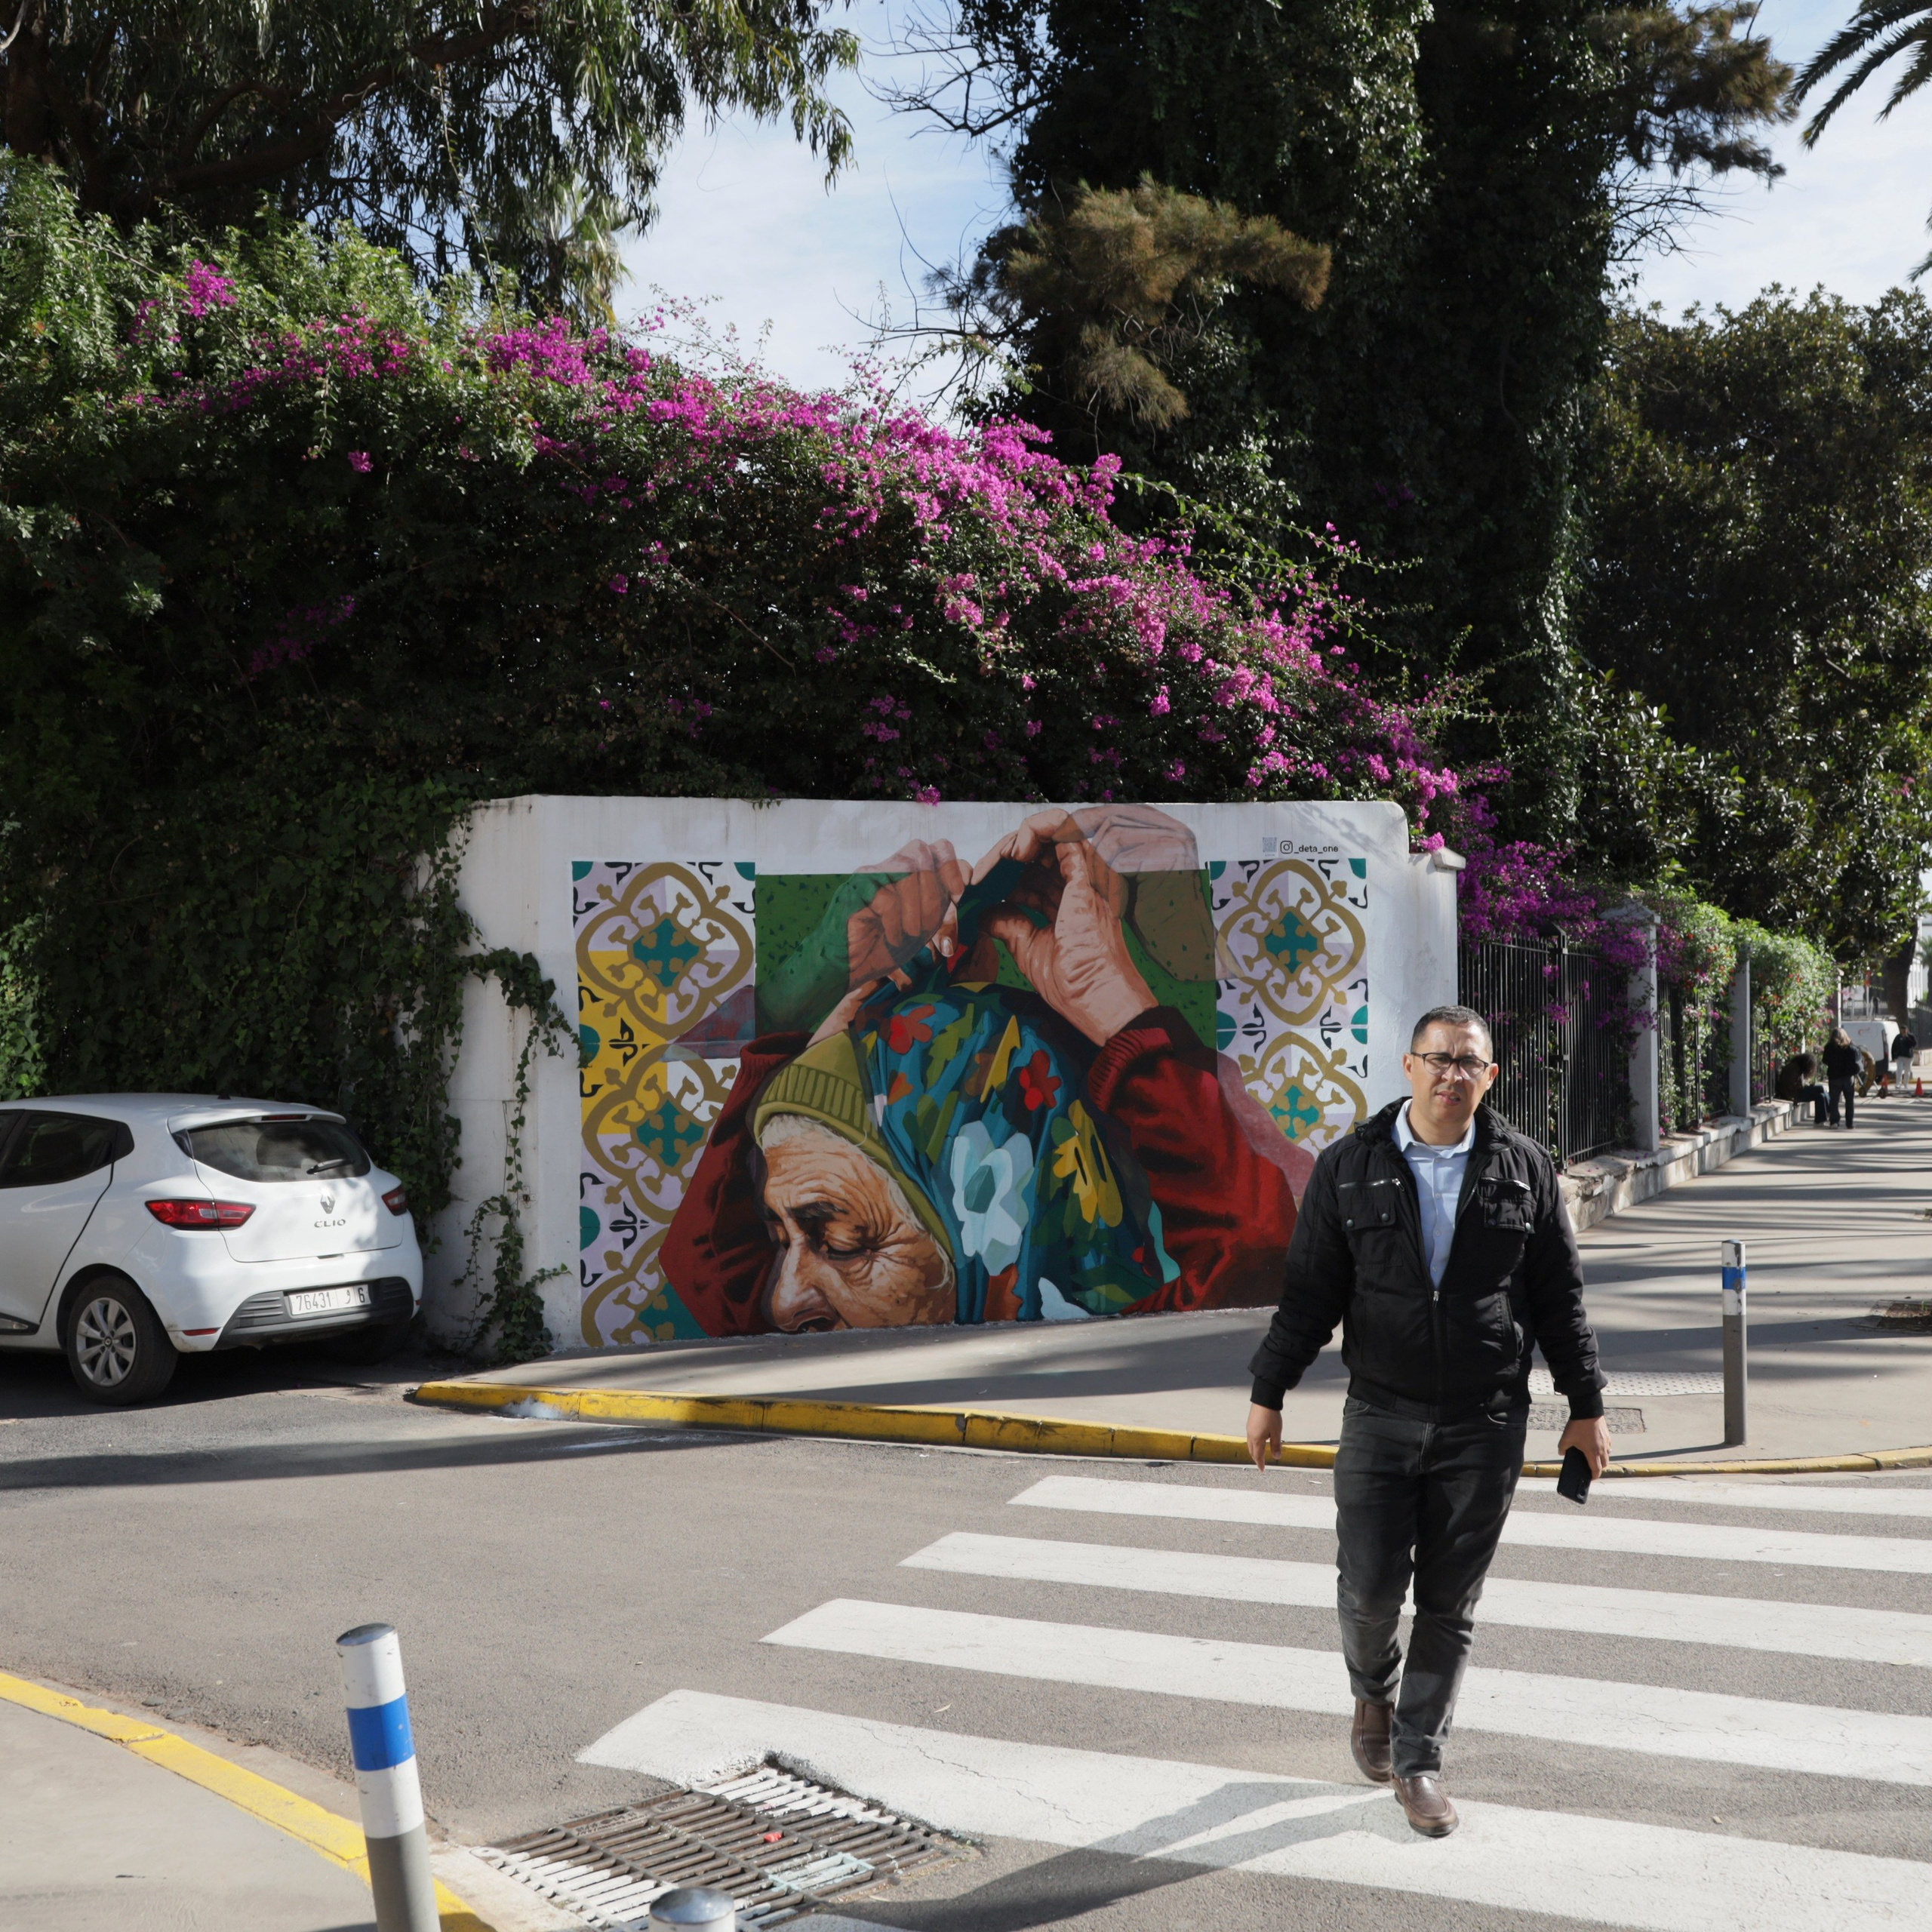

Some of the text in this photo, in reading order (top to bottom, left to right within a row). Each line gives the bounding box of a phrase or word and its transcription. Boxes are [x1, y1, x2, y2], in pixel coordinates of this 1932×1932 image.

[1294, 844, 1339, 854] _deta_one
[314, 1219, 346, 1228] CLIO
[296, 1291, 332, 1311] 76431
[358, 1287, 365, 1303] 6
